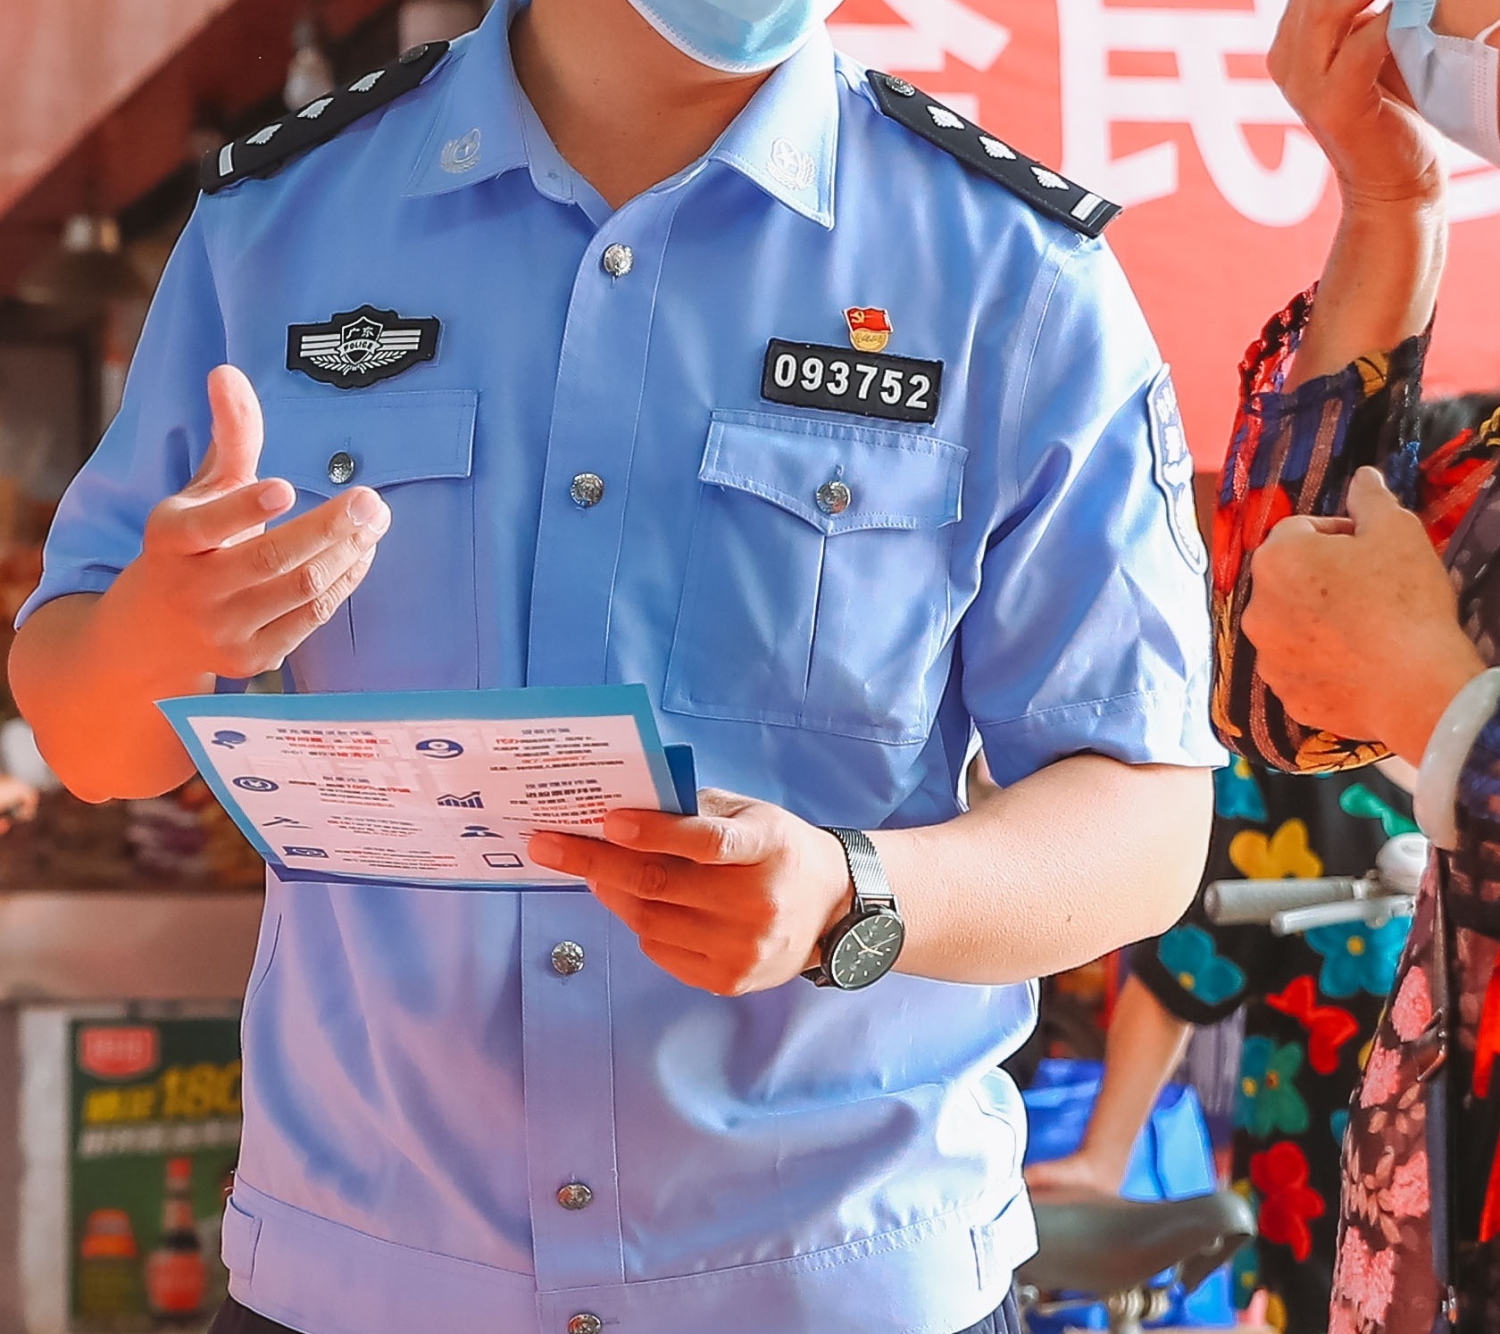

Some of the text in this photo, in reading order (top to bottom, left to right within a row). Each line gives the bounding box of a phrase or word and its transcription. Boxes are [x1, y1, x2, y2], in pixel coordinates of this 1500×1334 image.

[345, 325, 375, 340] 广东
[343, 340, 374, 351] POLICE
[774, 354, 931, 409] 093752
